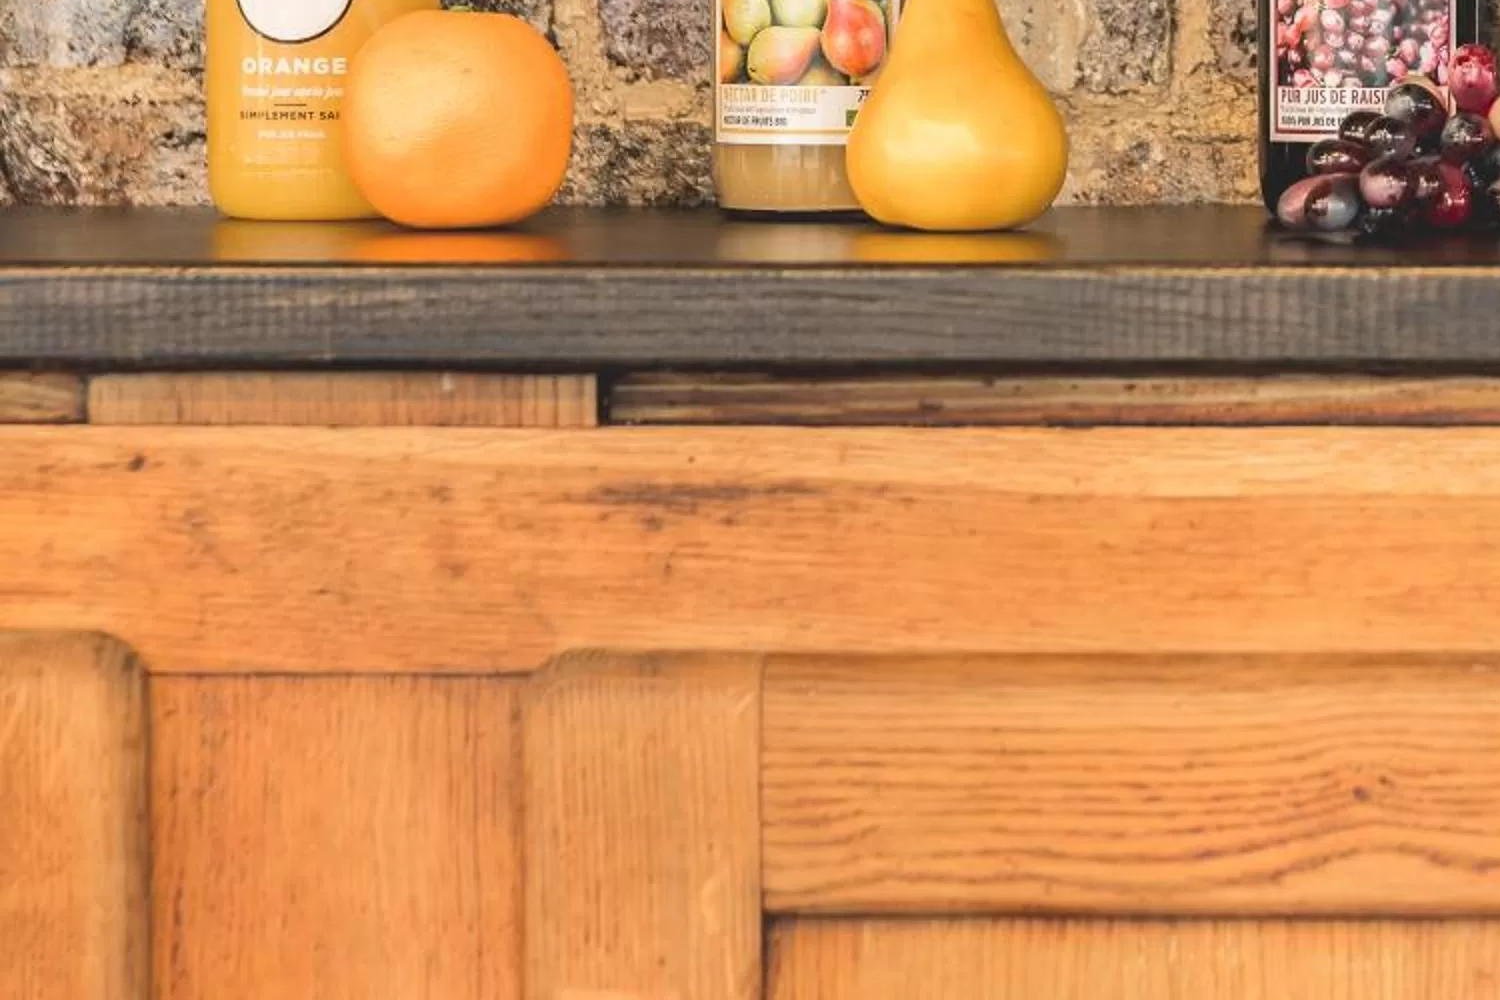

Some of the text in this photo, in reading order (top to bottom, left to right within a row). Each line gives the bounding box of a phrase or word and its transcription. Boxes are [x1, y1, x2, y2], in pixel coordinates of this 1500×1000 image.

[241, 57, 347, 75] ORANGE
[761, 88, 777, 103] DE
[1281, 89, 1385, 105] PUR JUS DE RAISI
[239, 110, 315, 121] SIMPLEMENT
